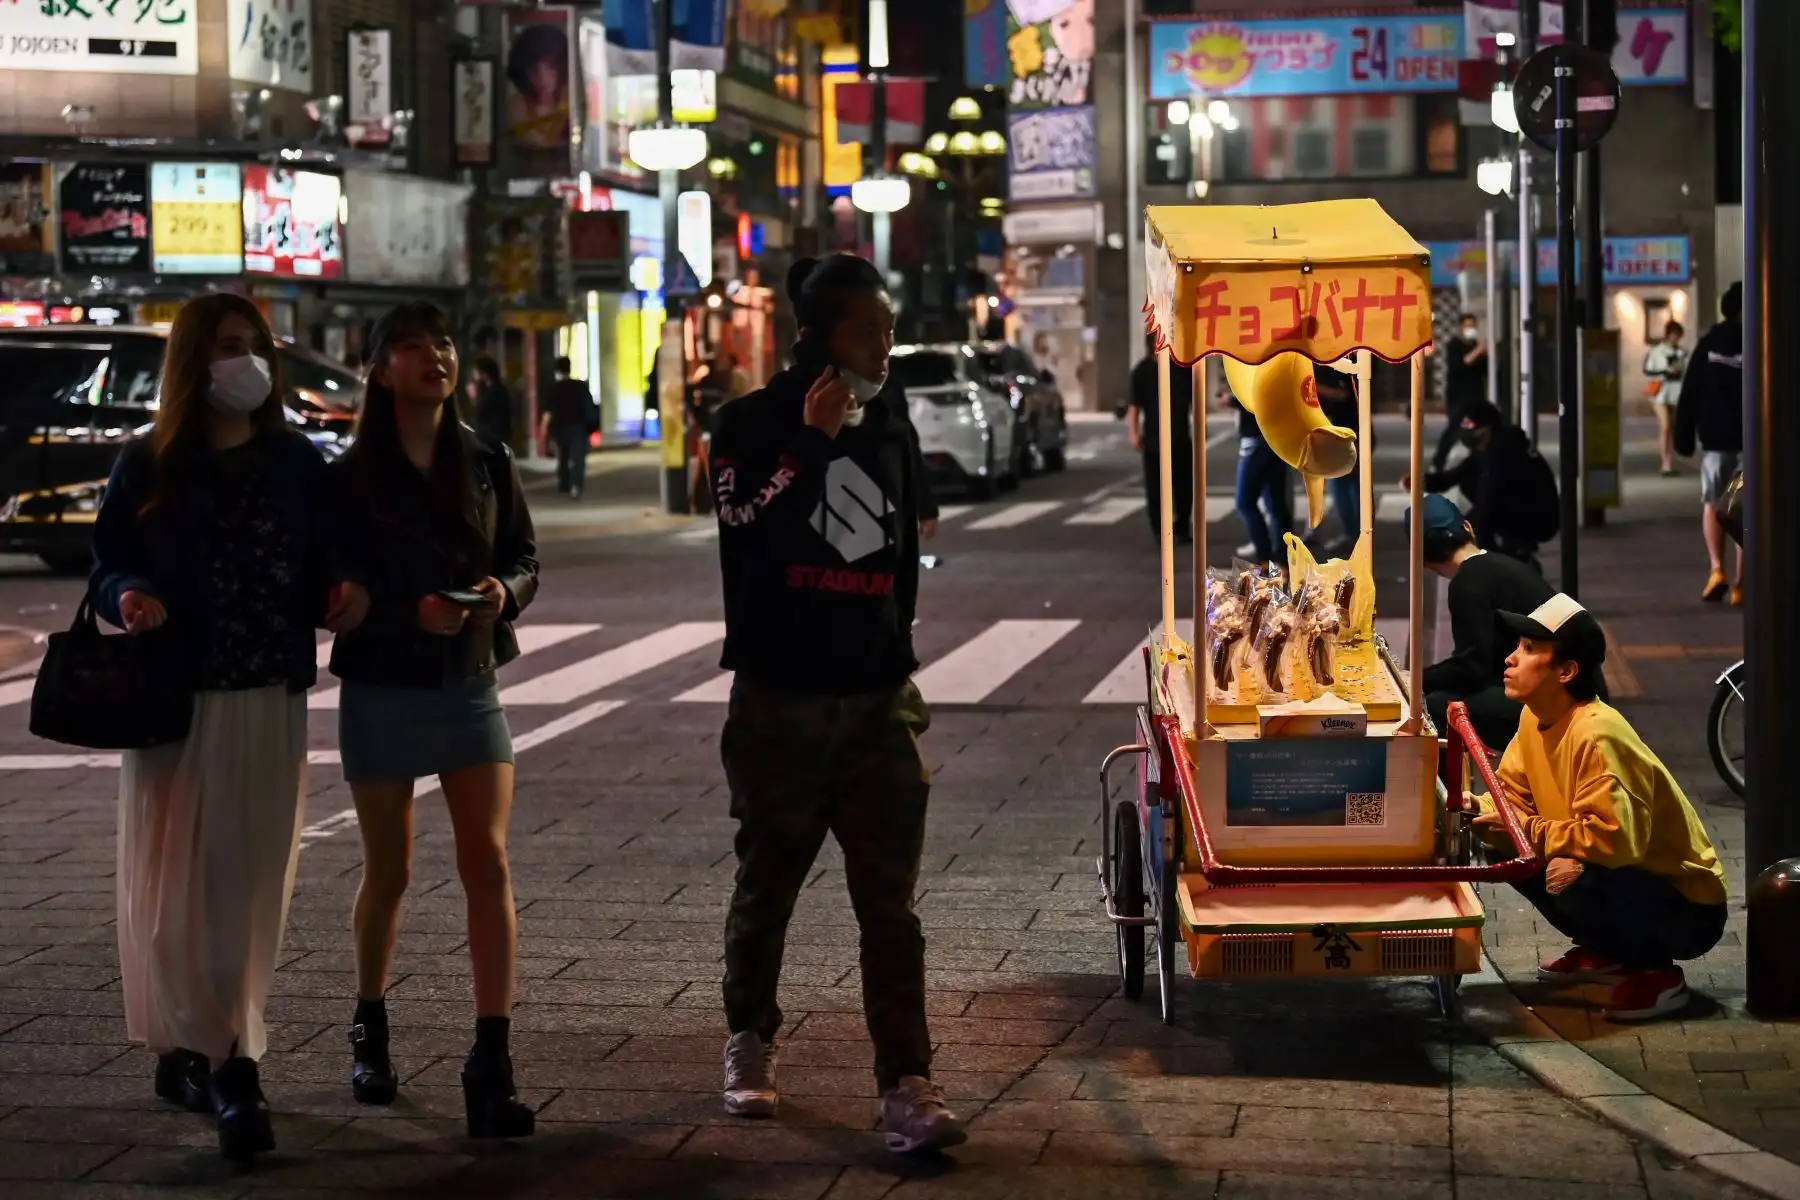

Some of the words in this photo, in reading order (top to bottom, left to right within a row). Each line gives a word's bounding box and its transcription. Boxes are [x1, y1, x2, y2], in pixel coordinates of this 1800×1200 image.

[11, 36, 78, 55] JOJOEN
[1351, 26, 1388, 80] 24
[1395, 56, 1457, 81] OPEN
[1618, 259, 1681, 275] OPEN
[1194, 275, 1418, 346] チョコバナナ
[786, 564, 895, 597] STADIUM
[1320, 717, 1356, 730] Kleenex
